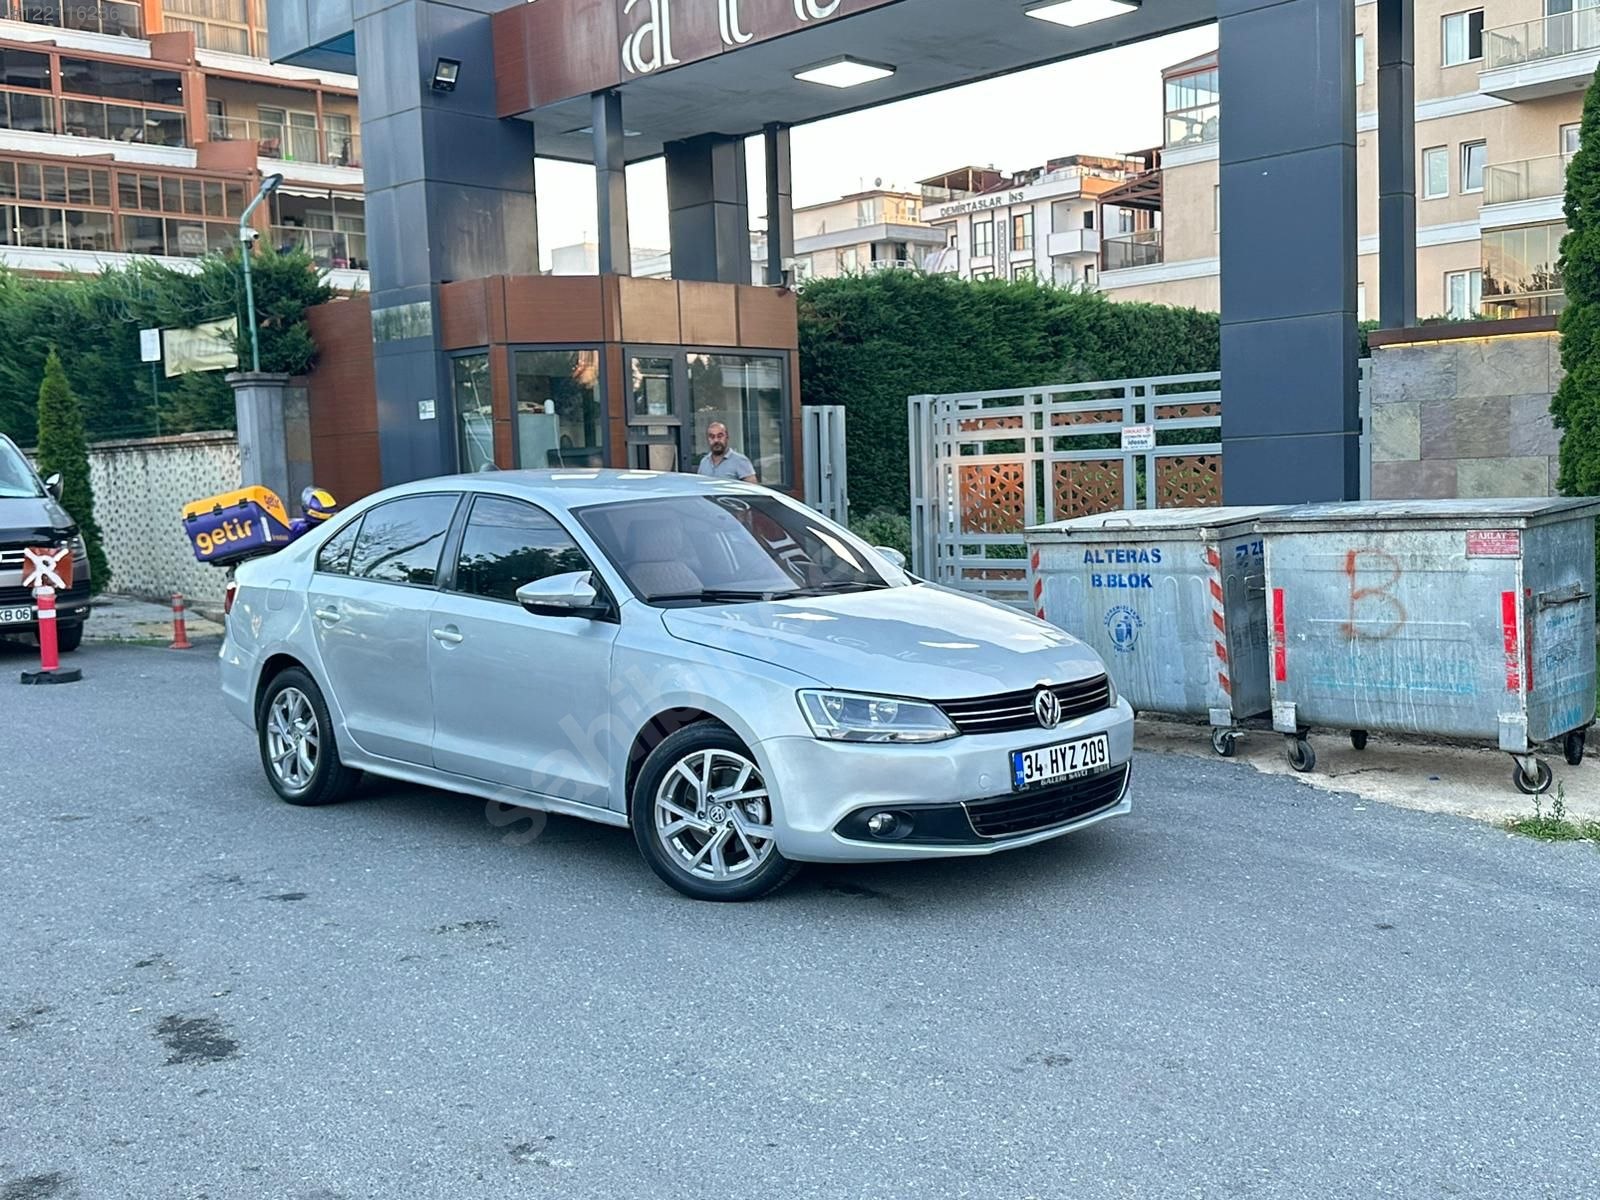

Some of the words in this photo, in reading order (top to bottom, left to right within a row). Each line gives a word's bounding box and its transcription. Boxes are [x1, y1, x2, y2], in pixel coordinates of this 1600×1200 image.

[195, 517, 252, 556] getir
[1083, 548, 1162, 564] ALTERAS
[1090, 572, 1153, 589] B.BLOK
[1340, 548, 1408, 641] B
[15, 609, 30, 620] 06
[1024, 752, 1043, 780] 34
[1050, 744, 1077, 775] HYZ
[1081, 738, 1105, 767] 209
